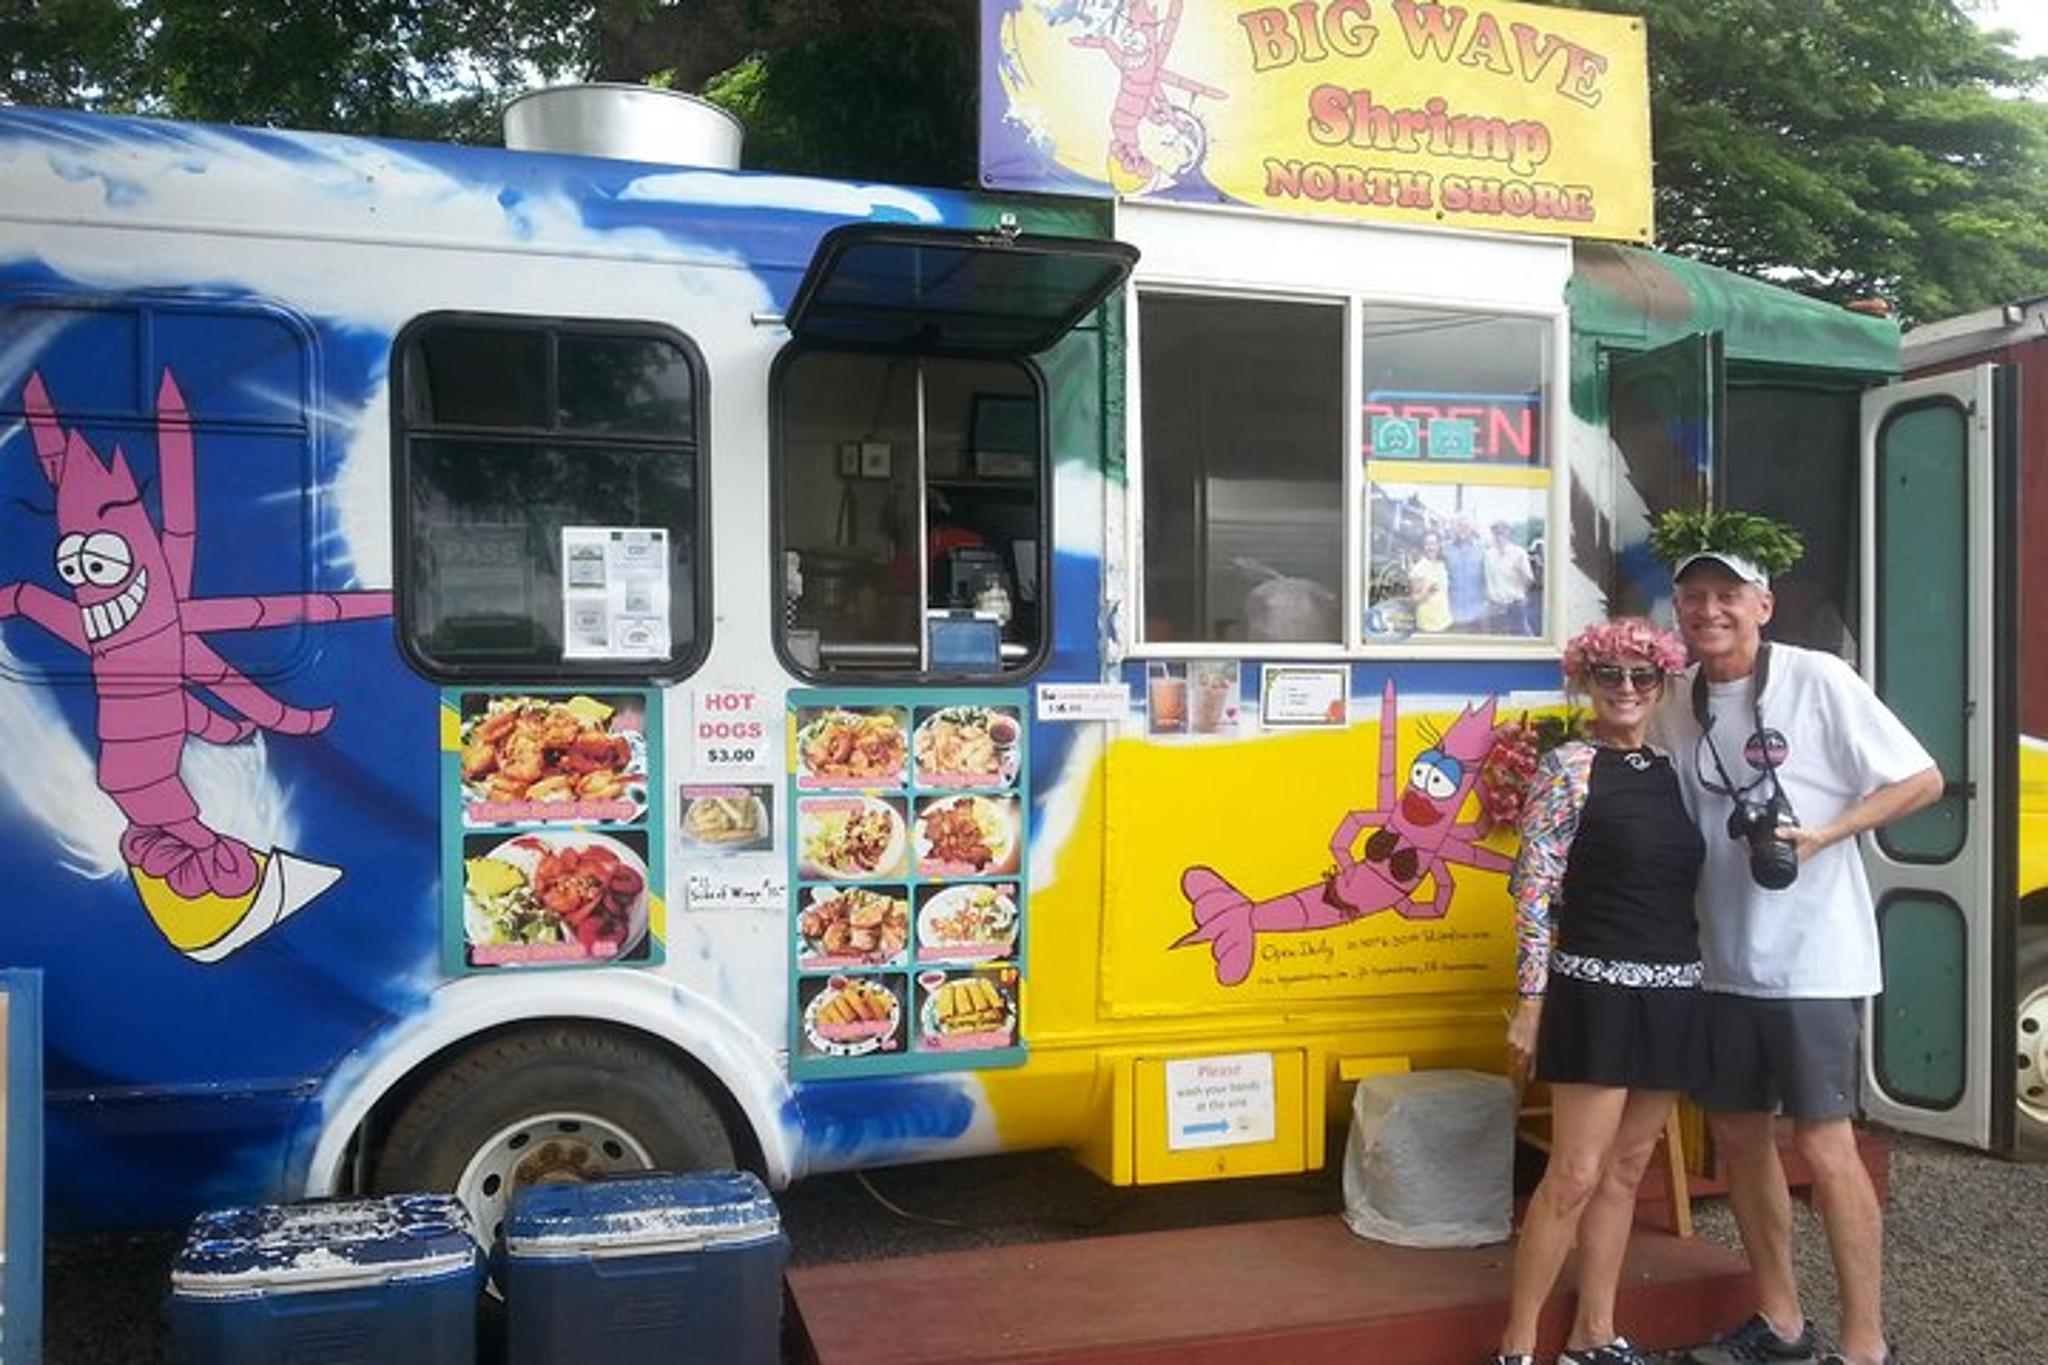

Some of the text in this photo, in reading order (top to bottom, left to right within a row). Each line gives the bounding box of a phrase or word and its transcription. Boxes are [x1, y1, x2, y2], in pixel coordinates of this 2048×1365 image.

[1238, 0, 1608, 108] BIG WAVE
[1309, 83, 1551, 176] Shrimp
[1263, 157, 1596, 222] NORTH SHORE
[705, 693, 756, 711] HOT
[699, 722, 762, 740] DOGS
[707, 748, 755, 763] $3.00
